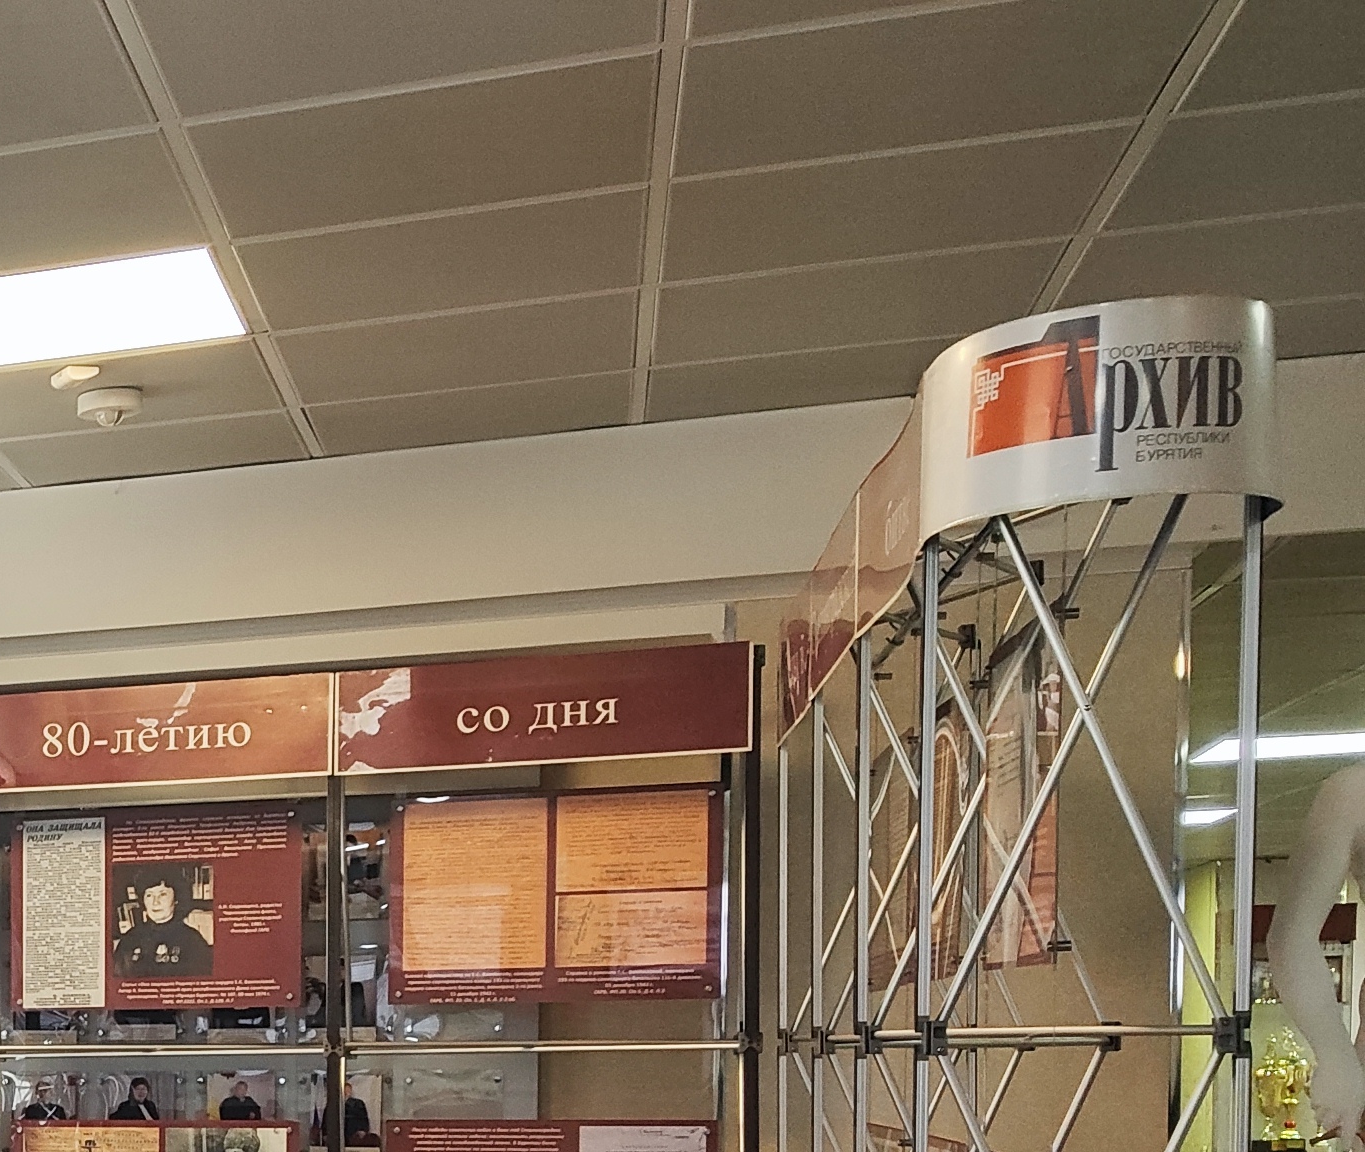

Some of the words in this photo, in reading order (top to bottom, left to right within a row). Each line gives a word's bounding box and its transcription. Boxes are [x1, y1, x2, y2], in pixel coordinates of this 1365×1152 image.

[1135, 431, 1231, 447] РЕСПУБЛИКИ
[1135, 447, 1203, 462] БУРЯТИЯ
[41, 721, 252, 758] 80-летию
[456, 705, 511, 734] со
[528, 697, 619, 734] дня
[26, 824, 44, 834] ОНА
[48, 821, 102, 832] ЗАЩИЩАЛА
[26, 833, 63, 843] РОДИНУ
